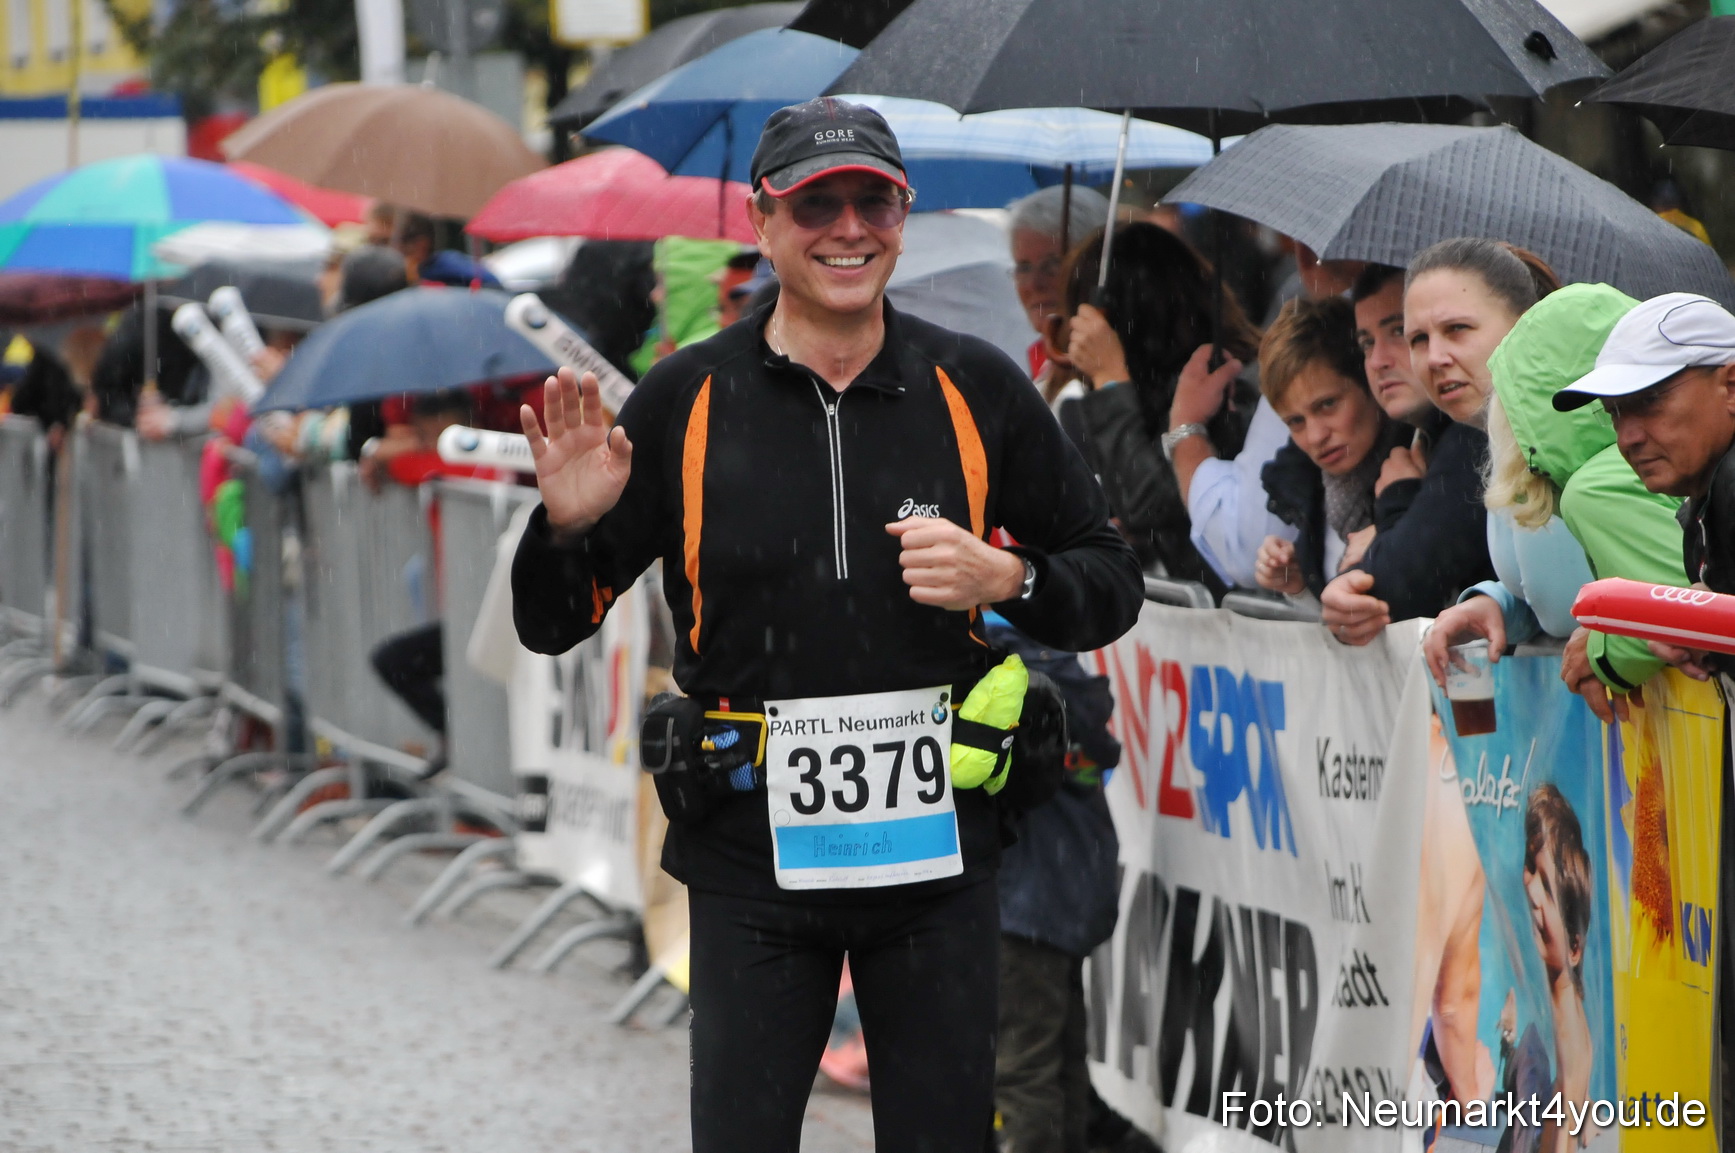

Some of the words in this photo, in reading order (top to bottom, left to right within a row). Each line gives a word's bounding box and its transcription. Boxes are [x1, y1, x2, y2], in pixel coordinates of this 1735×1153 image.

[814, 129, 855, 141] GORE
[769, 718, 833, 736] PARTL
[838, 710, 925, 733] Neumarkt
[787, 735, 946, 815] 3379
[813, 831, 893, 858] Heinrich
